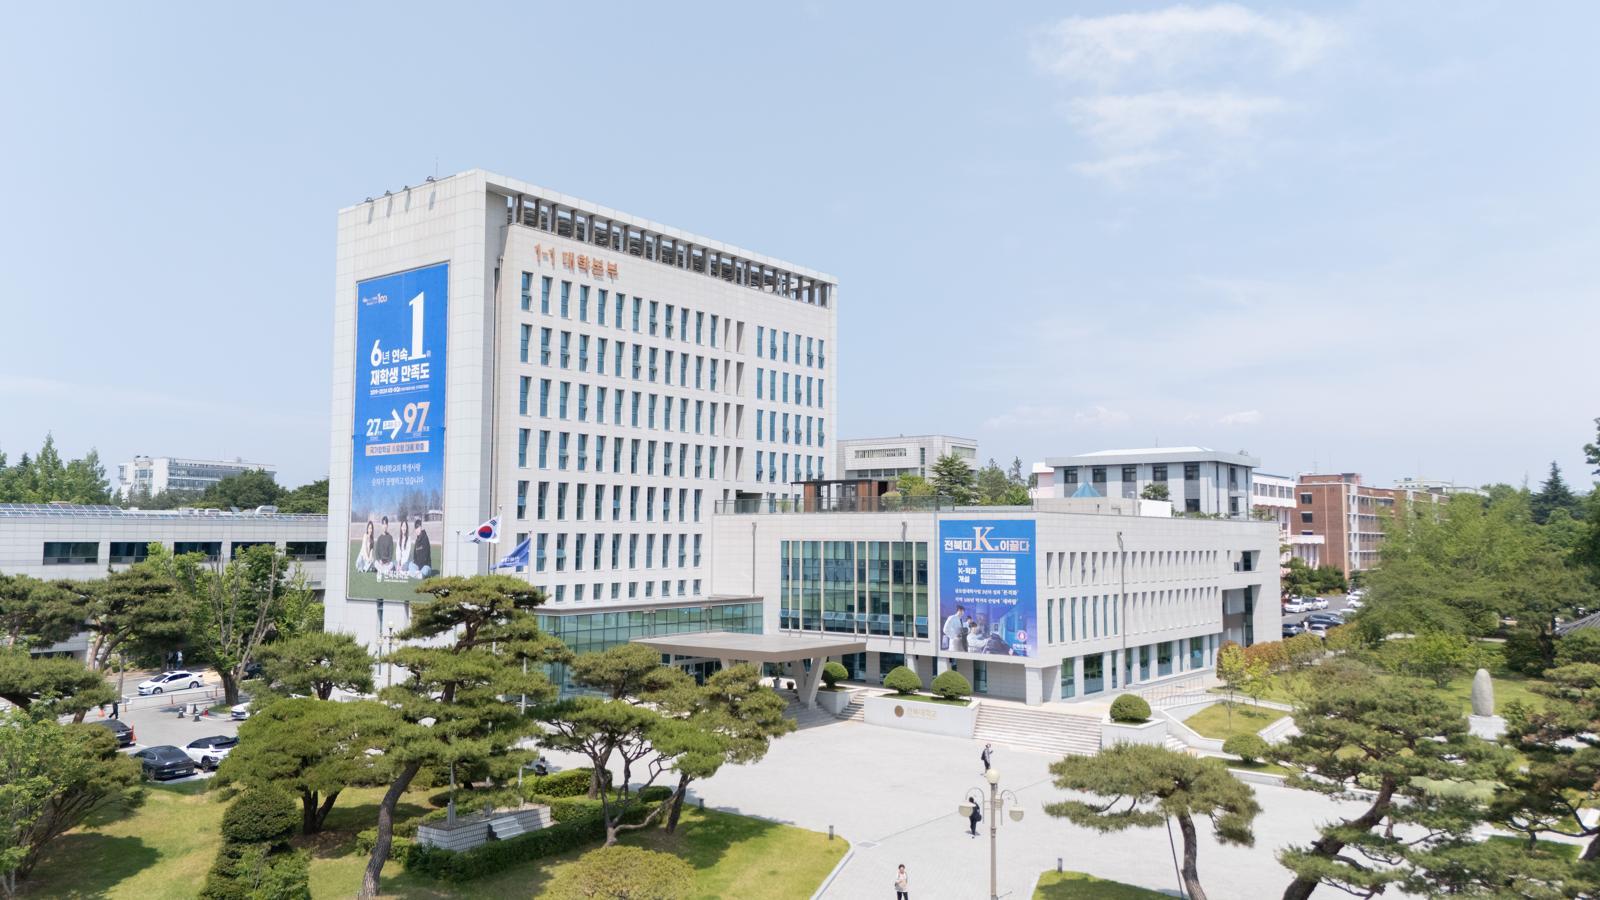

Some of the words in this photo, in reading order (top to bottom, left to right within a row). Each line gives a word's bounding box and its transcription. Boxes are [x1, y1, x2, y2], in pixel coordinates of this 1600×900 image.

[561, 251, 619, 281] 대학본부
[370, 339, 390, 367] 6년
[391, 347, 408, 362] 연속
[370, 366, 398, 386] 재학생
[401, 362, 430, 382] 만족도
[944, 540, 972, 551] 전북대
[1000, 540, 1030, 552] 이끌다
[958, 567, 977, 575] K-학과
